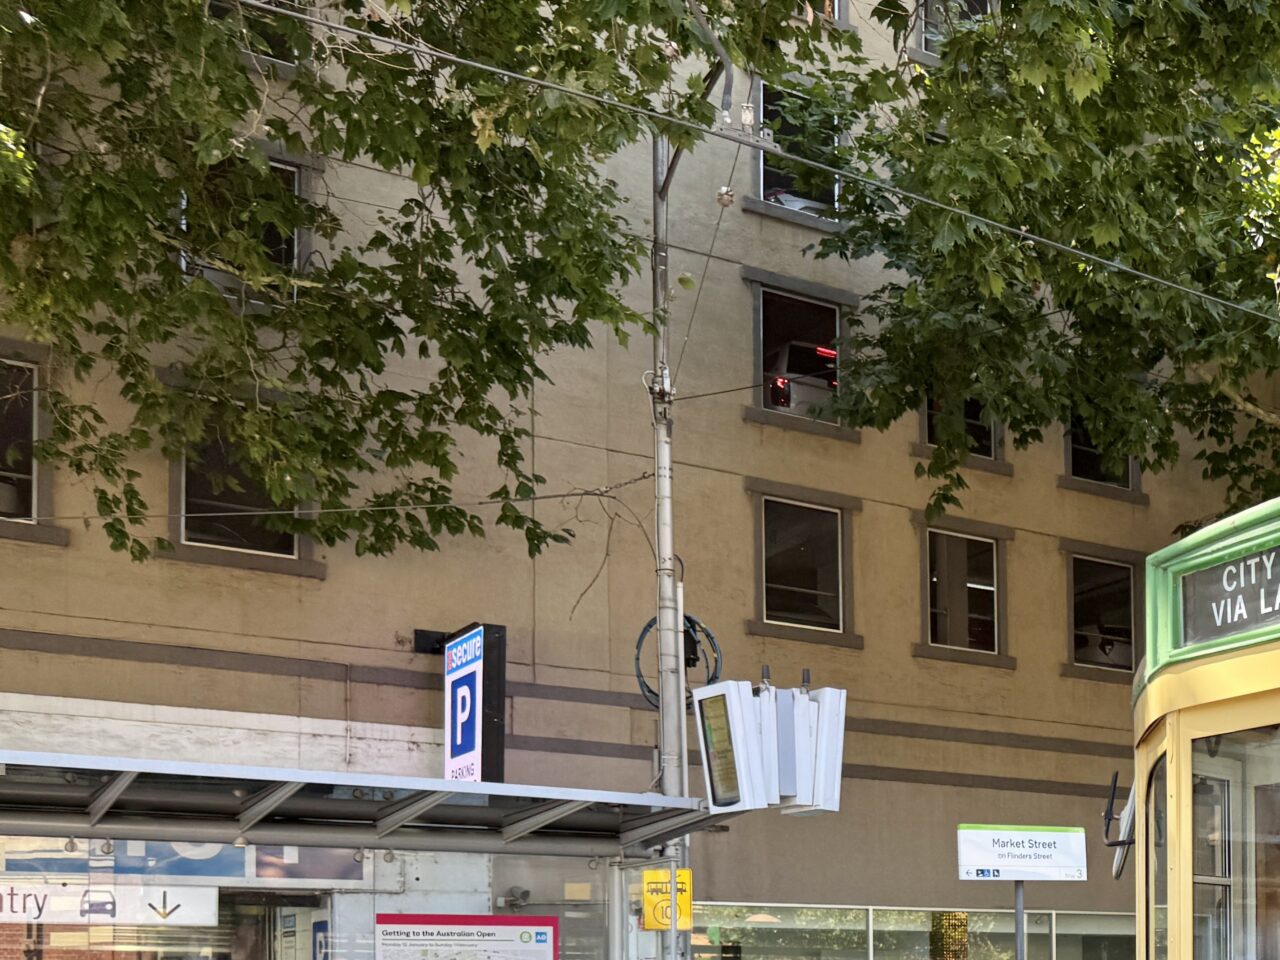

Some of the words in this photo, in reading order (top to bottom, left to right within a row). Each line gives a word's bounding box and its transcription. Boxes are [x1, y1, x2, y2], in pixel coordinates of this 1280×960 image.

[1222, 550, 1277, 593] CITY
[1211, 593, 1248, 627] VIA
[456, 685, 471, 745] P
[992, 838, 1026, 849] Market
[1028, 839, 1057, 849] Street
[1007, 852, 1032, 860] Flinders
[1033, 852, 1053, 860] Street
[1076, 869, 1083, 879] 3
[381, 929, 411, 938] Getting
[436, 930, 475, 938] Australian
[476, 931, 496, 939] Open
